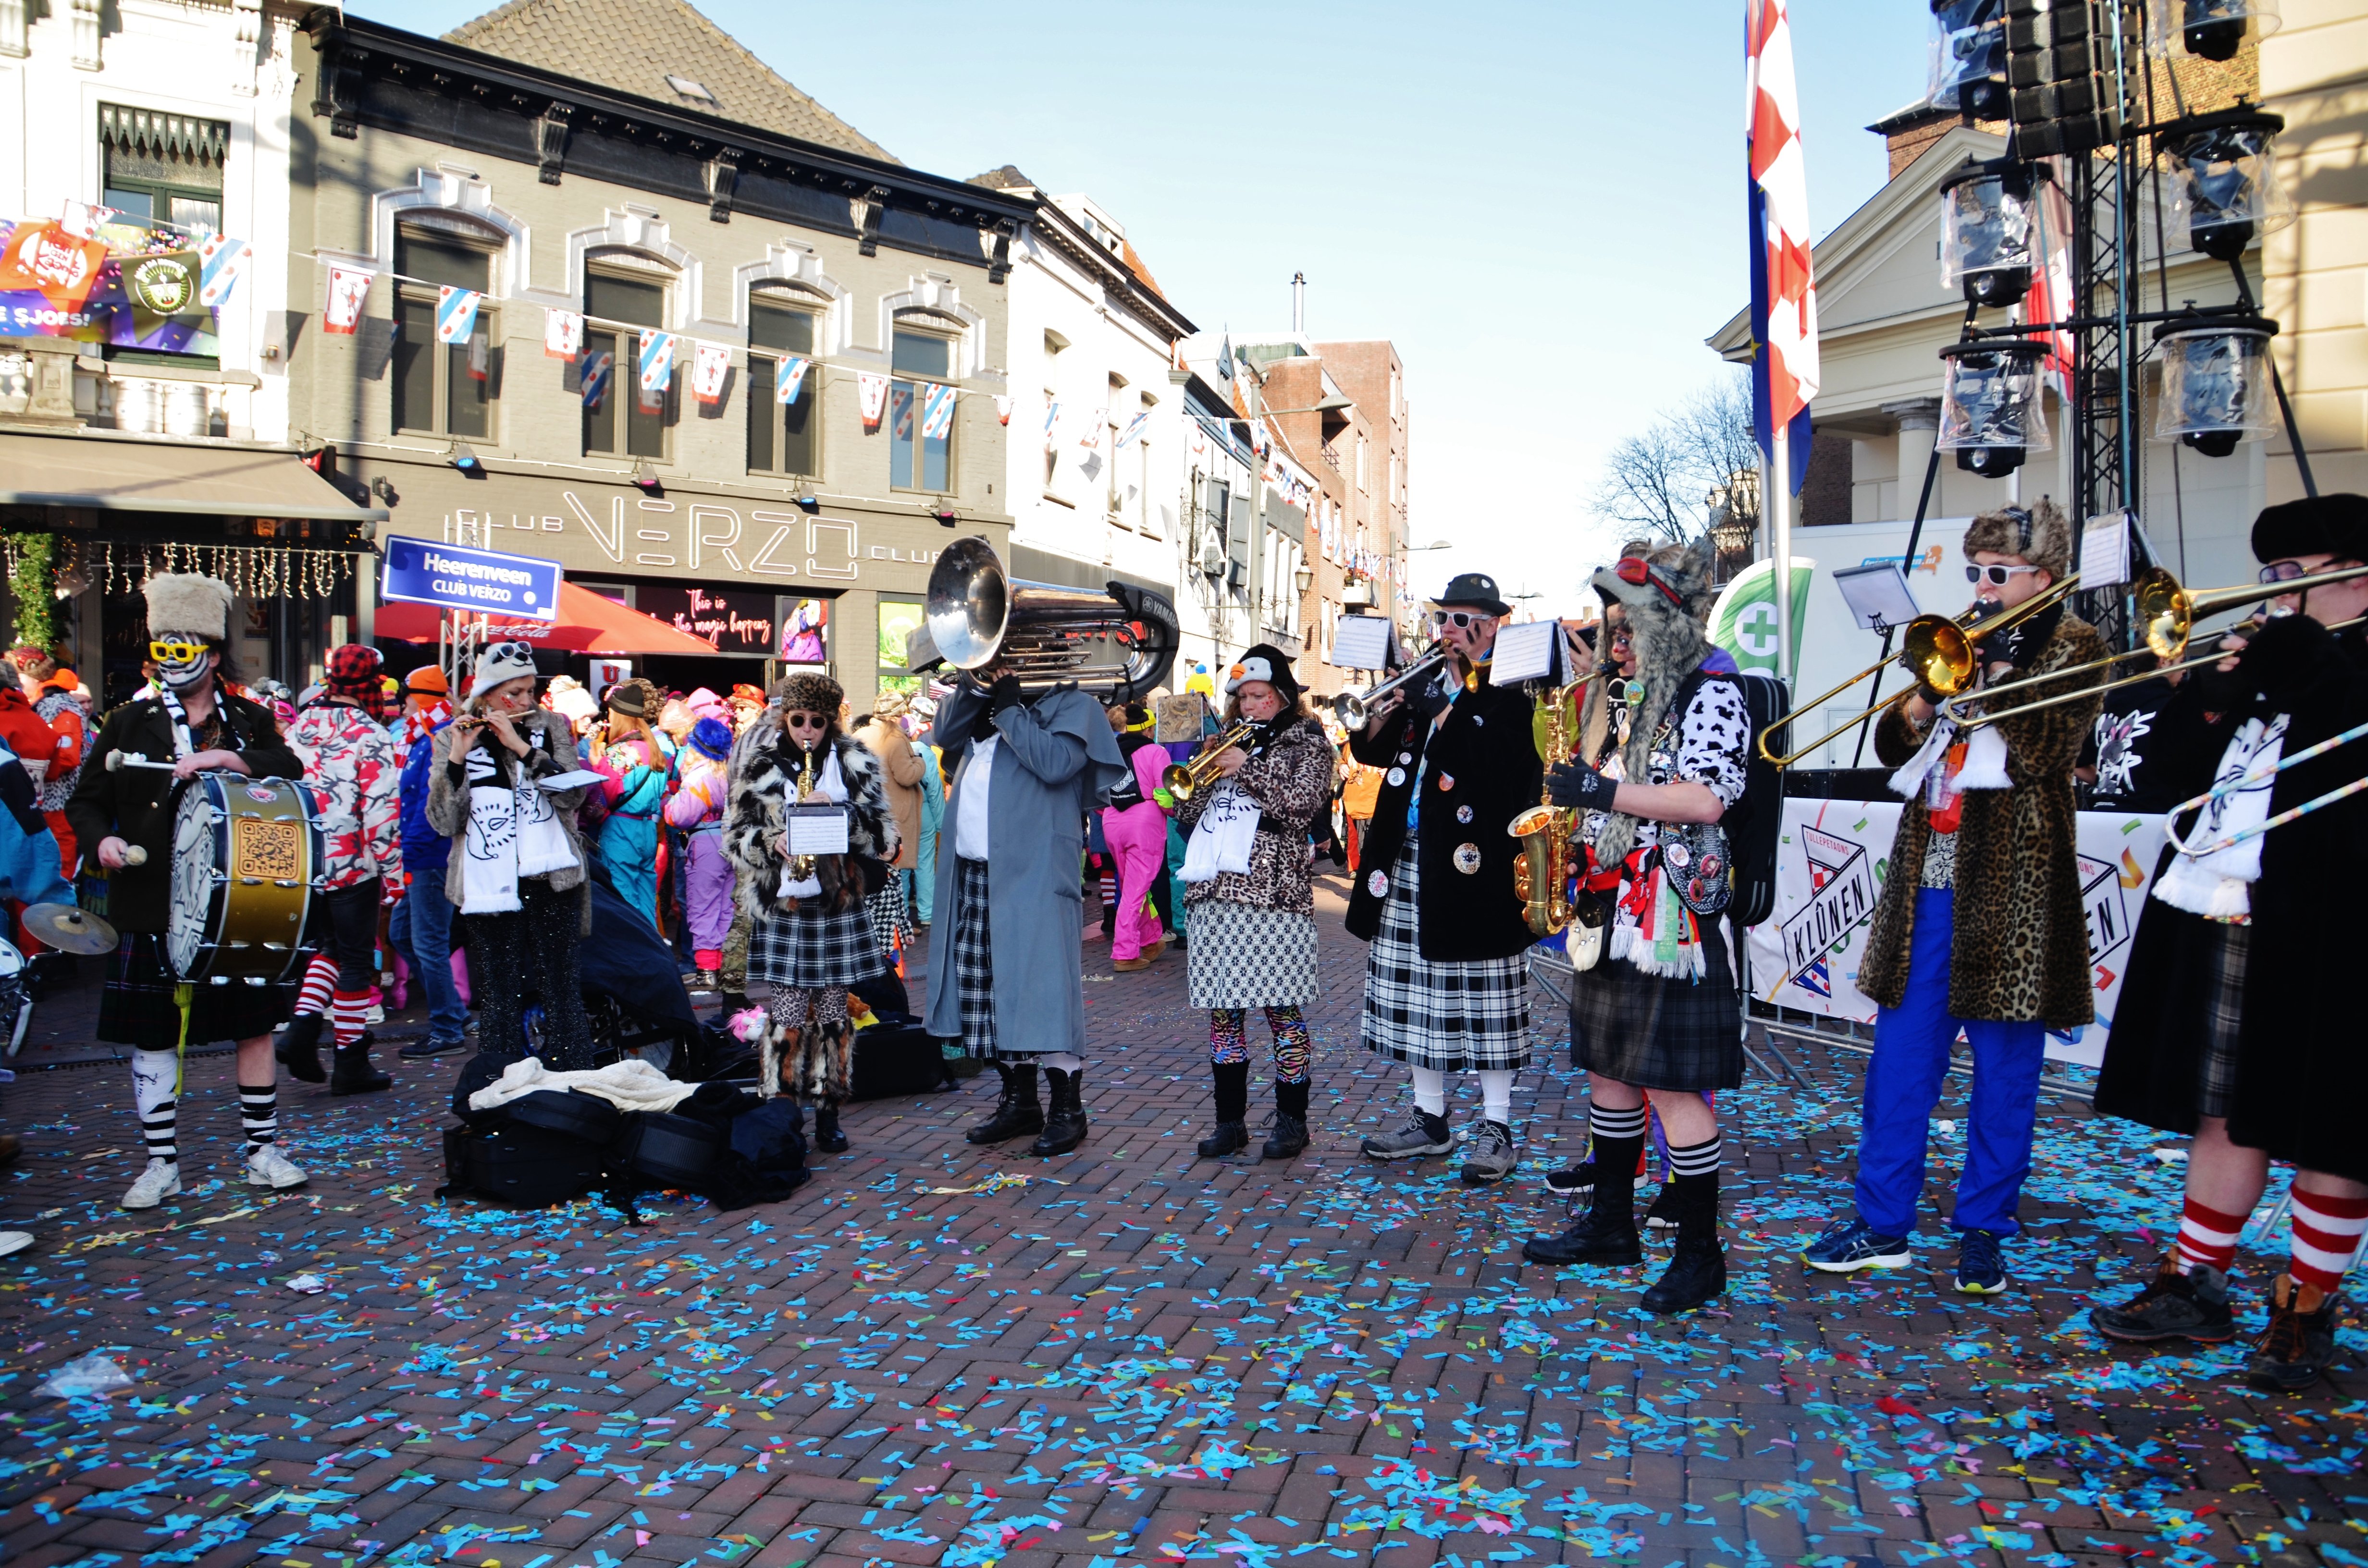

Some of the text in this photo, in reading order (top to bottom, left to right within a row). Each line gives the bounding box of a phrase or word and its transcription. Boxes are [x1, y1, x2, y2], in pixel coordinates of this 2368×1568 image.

[13, 307, 91, 327] SJOES!
[563, 491, 857, 580] VERZO
[423, 552, 532, 586] Heerenveen
[432, 579, 511, 602] CLUB VERZO
[685, 588, 713, 619] This
[714, 596, 727, 610] is
[694, 617, 728, 644] magic
[1154, 600, 1179, 631] YAMAHA
[1805, 831, 1850, 856] TULLEPETAONS
[1793, 873, 1865, 967] KLÛNEN
